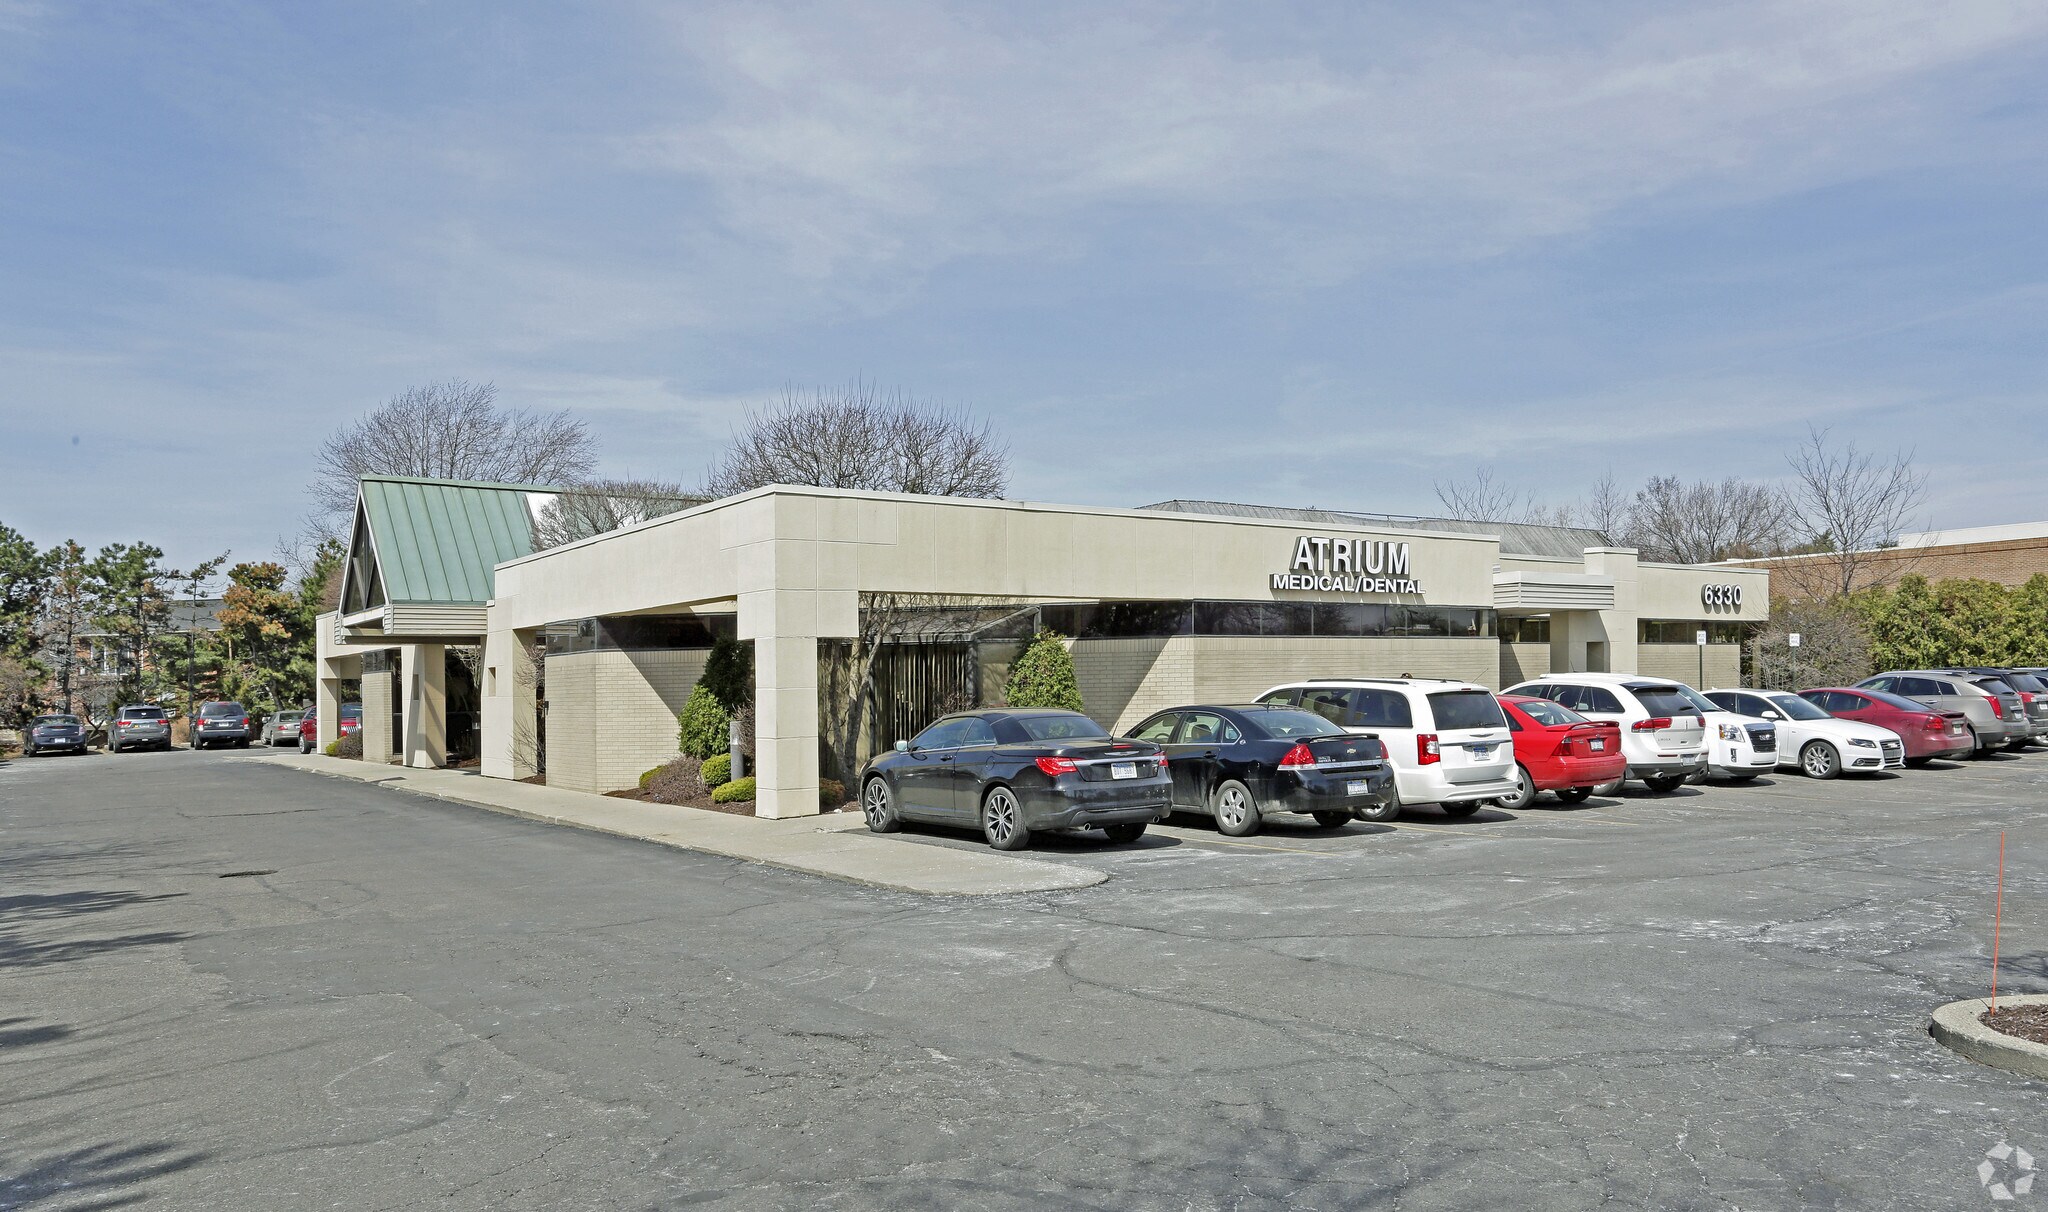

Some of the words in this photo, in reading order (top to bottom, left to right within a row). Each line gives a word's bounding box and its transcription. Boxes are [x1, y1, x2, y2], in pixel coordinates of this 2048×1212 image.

[1291, 536, 1410, 575] ATRIUM
[1271, 573, 1426, 595] MEDICAL/DENTAL
[1702, 584, 1742, 605] 6330
